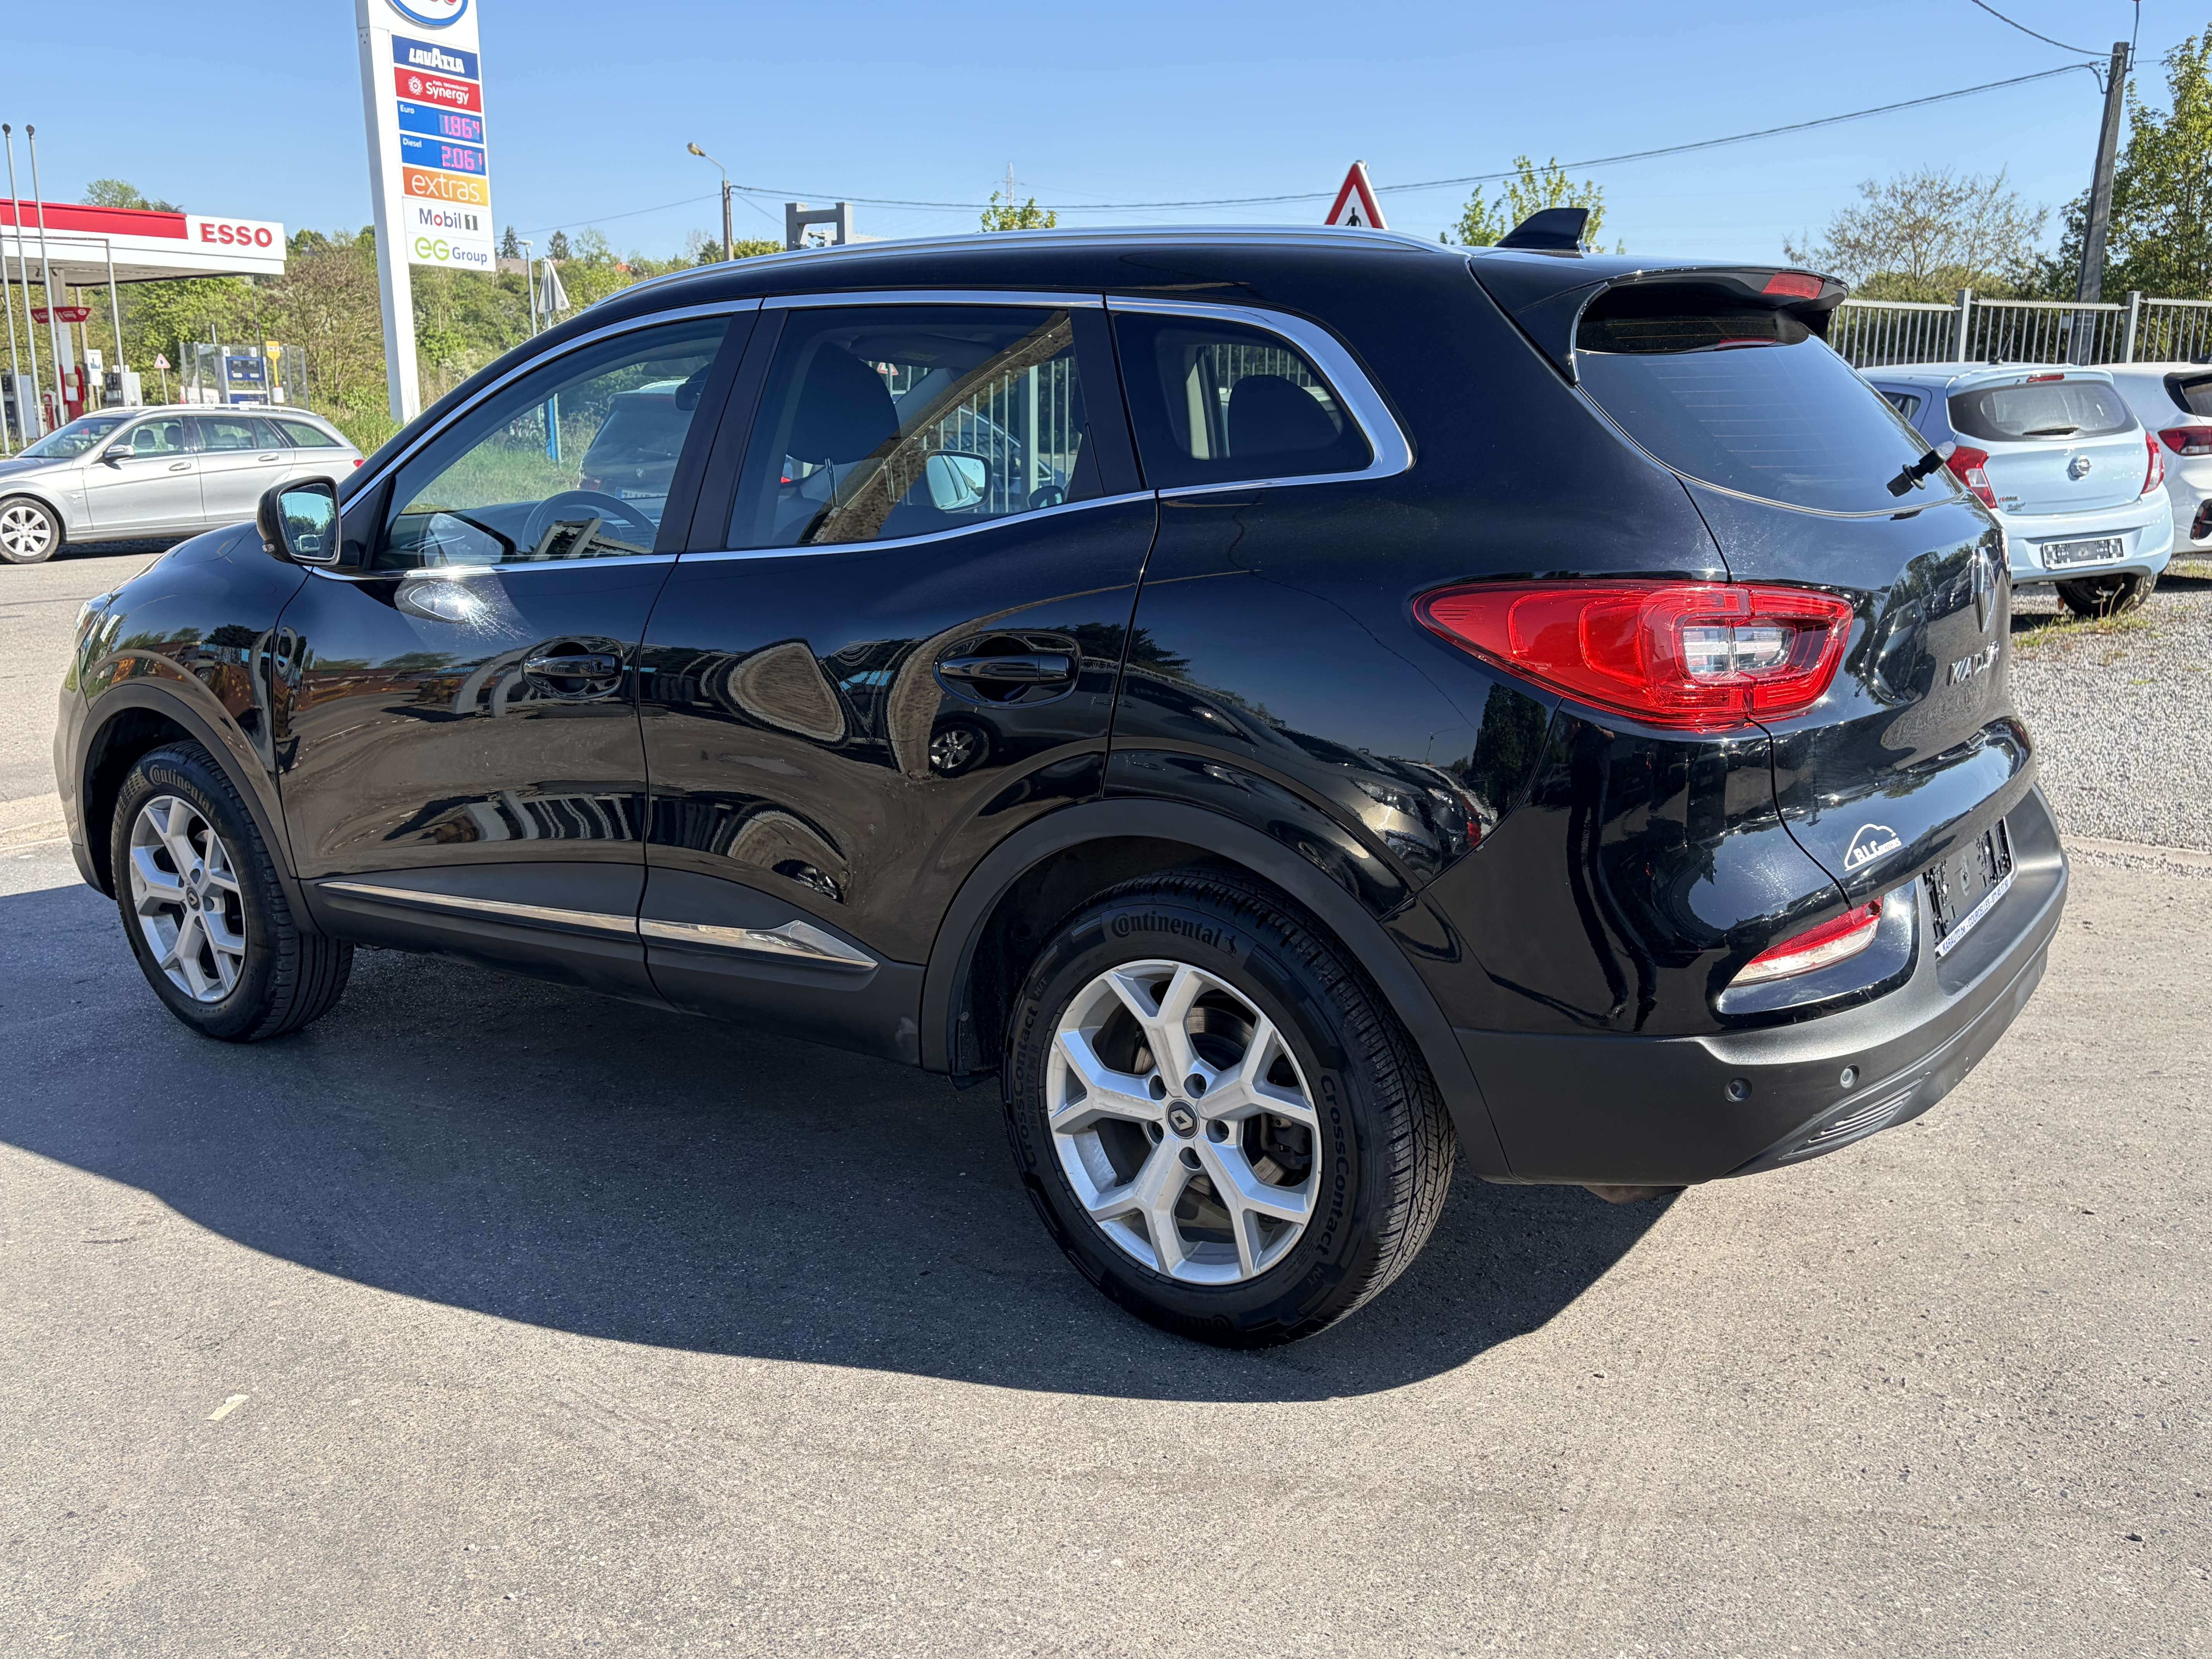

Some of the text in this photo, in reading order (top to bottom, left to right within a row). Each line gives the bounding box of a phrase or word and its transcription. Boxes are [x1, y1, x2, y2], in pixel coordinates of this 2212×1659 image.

[409, 48, 465, 74] LAVAZZA
[425, 81, 469, 105] Synergy
[400, 104, 415, 114] Euro
[402, 137, 422, 148] Diesel
[412, 174, 480, 202] extras
[419, 208, 476, 230] Mobil 1
[199, 223, 273, 248] ESSO
[452, 247, 487, 265] Group
[149, 764, 216, 819] Continental
[1111, 910, 1223, 949] Continental
[1013, 1006, 1039, 1168] CrossContact
[1316, 1075, 1350, 1256] CrossContact
